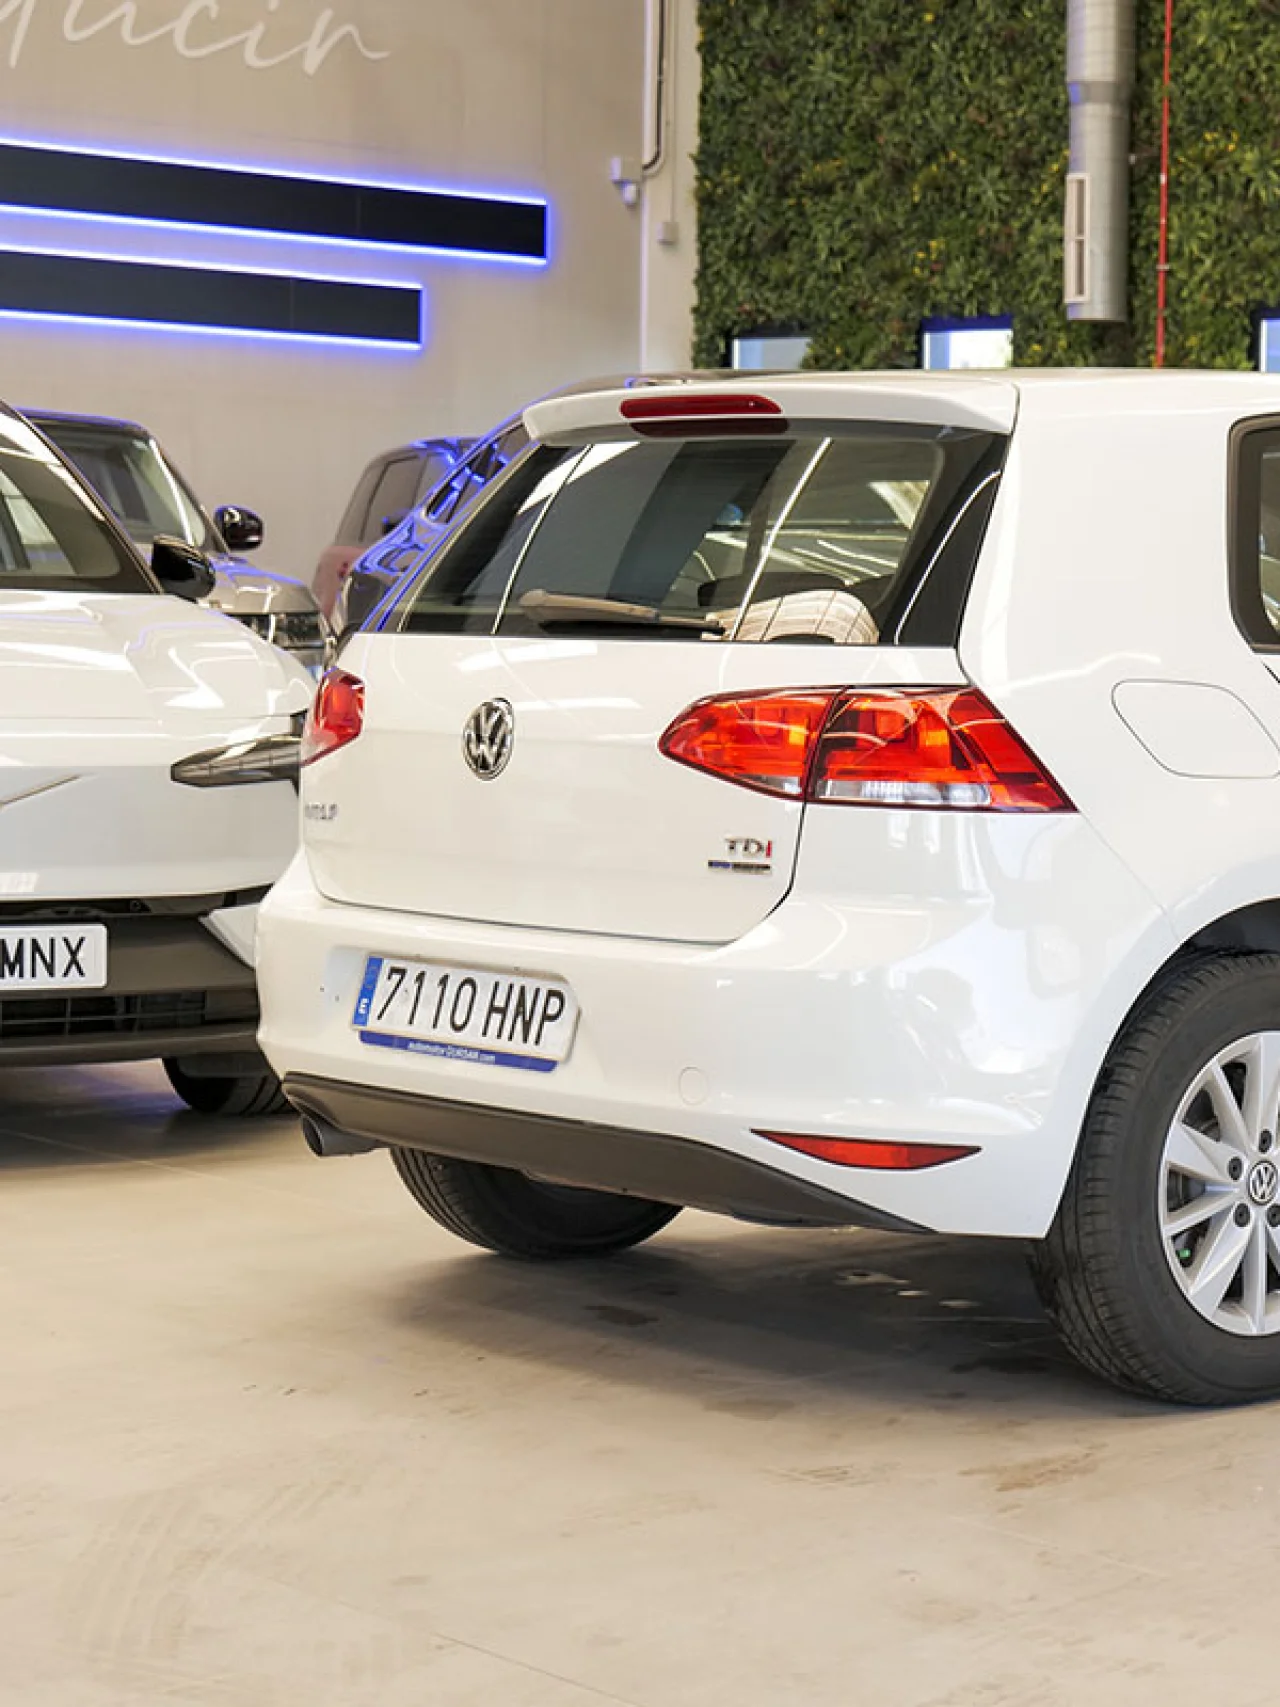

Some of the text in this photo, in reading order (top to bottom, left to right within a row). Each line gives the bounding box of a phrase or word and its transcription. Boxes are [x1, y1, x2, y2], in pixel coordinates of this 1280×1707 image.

[724, 837, 773, 858] TDI
[0, 936, 86, 979] MNX
[357, 997, 370, 1015] E
[376, 965, 567, 1046] 7110 HNP
